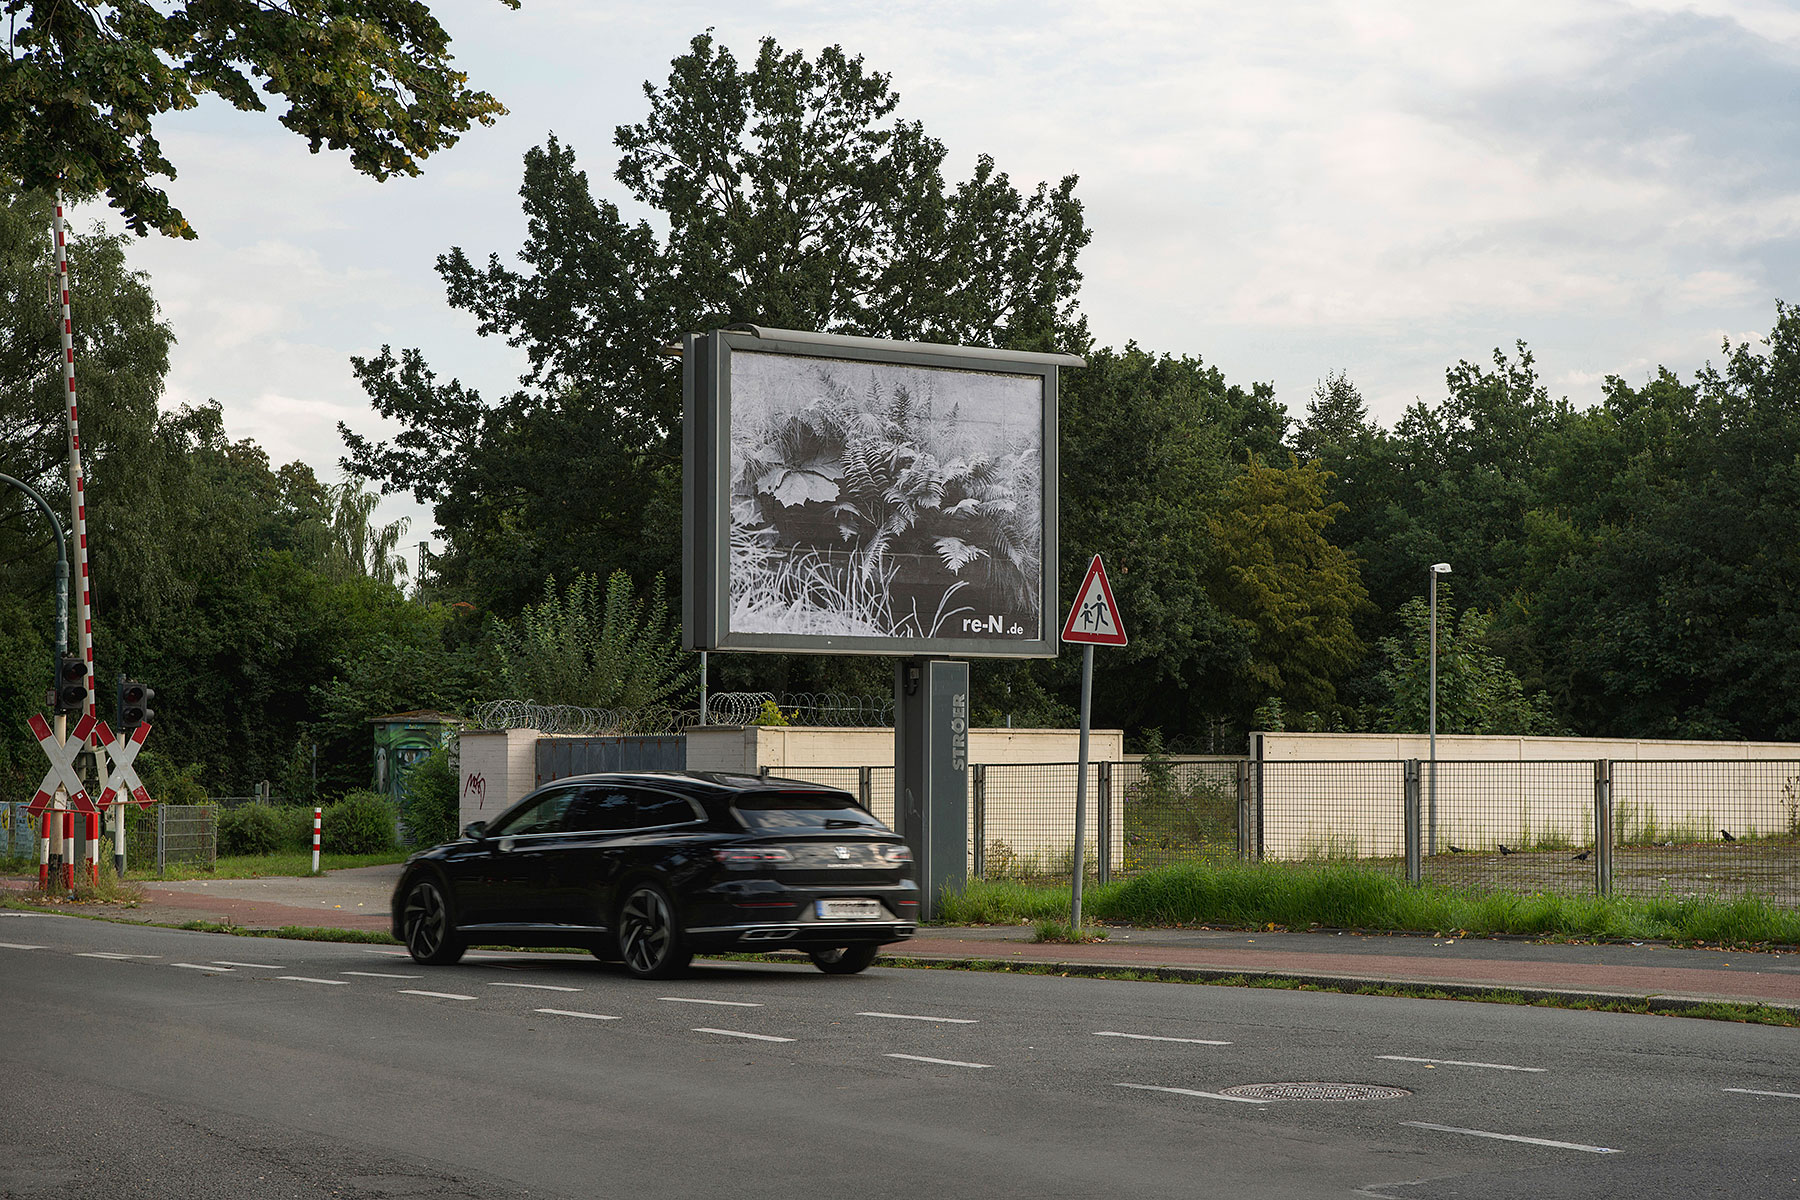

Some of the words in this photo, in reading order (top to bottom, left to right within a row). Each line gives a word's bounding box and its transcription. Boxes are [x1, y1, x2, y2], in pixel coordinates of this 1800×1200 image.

[962, 615, 1003, 633] re-N
[1006, 622, 1024, 635] .de
[951, 693, 965, 771] STRÖER
